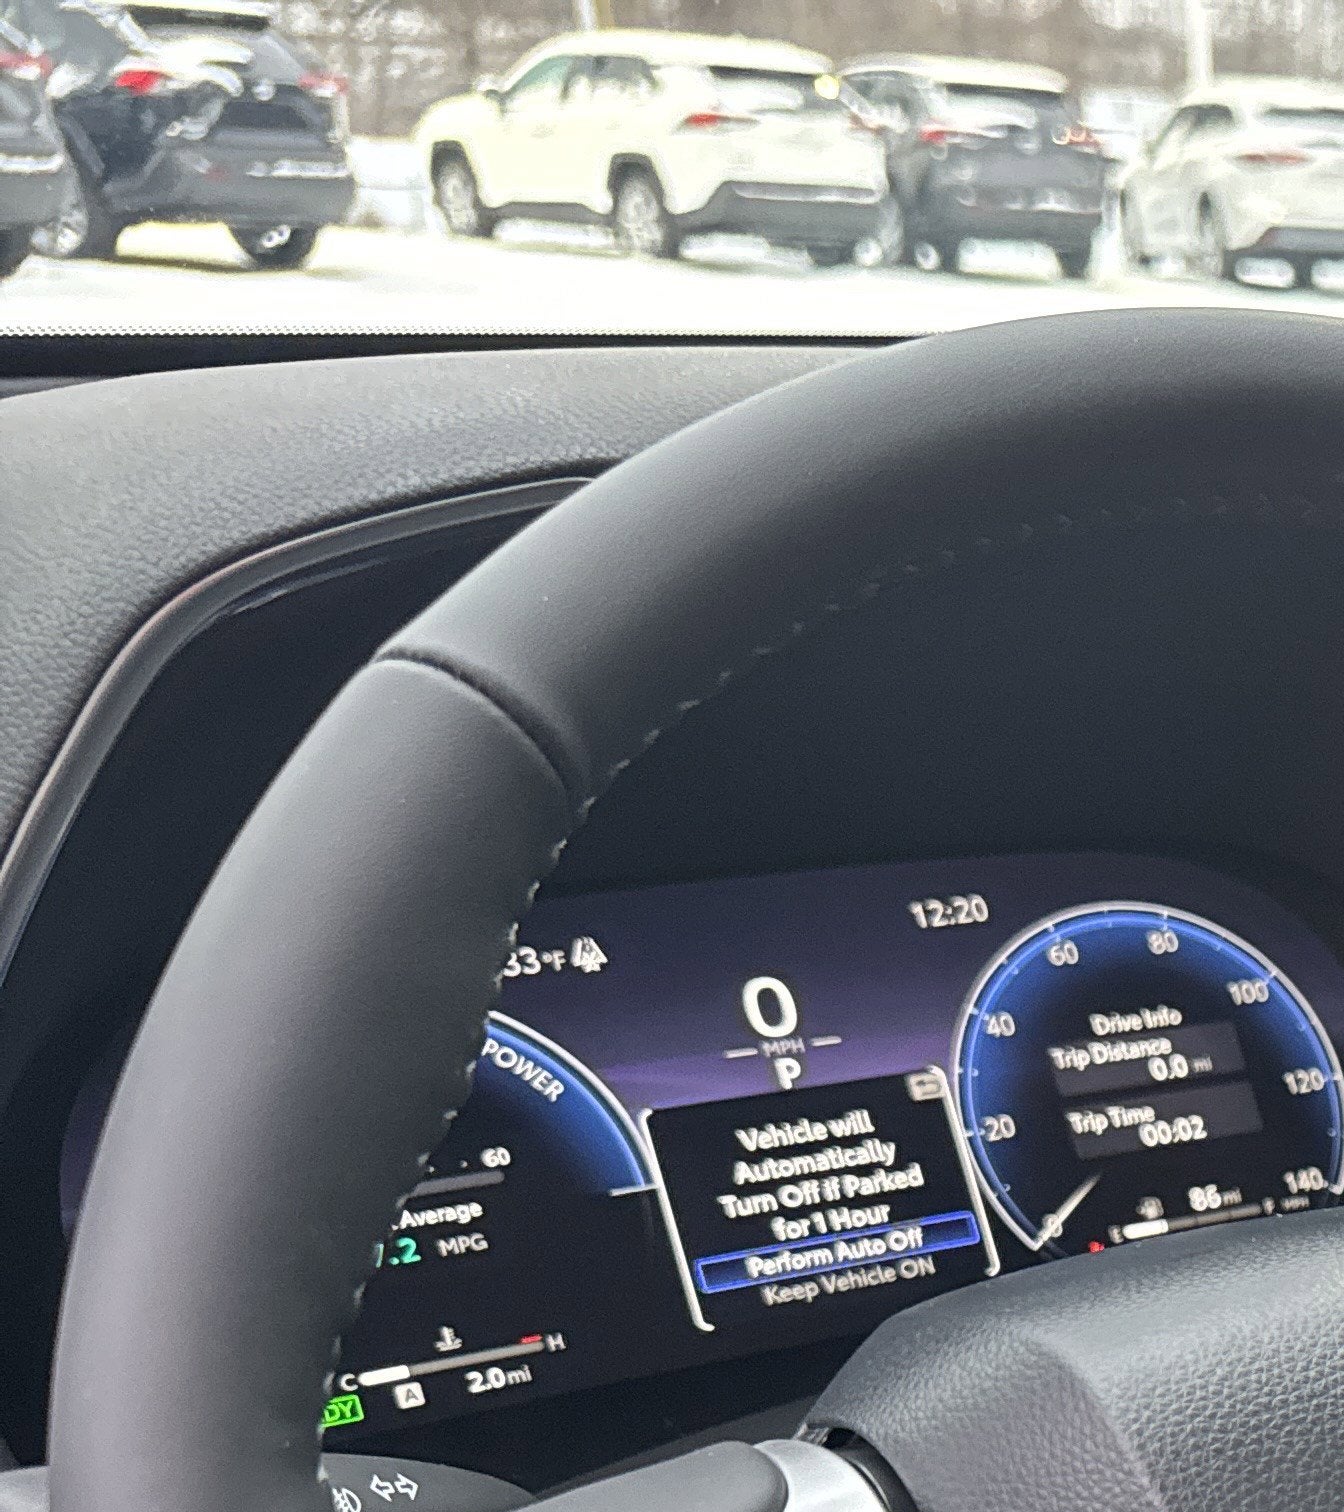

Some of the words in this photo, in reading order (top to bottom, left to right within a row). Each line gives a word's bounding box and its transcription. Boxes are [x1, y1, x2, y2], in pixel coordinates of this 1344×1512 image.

[910, 894, 989, 928] 12:20
[1046, 940, 1080, 966] 60
[1146, 930, 1180, 955] 80
[742, 975, 798, 1038] 0
[1228, 979, 1270, 1005] 100
[984, 1012, 1016, 1038] 40
[1090, 1010, 1138, 1036] Drive
[1139, 1004, 1183, 1031] Info
[481, 1037, 567, 1103] POWER
[1048, 1044, 1091, 1072] Trip
[1091, 1037, 1173, 1065] Distance
[1147, 1056, 1189, 1082] 0.0
[774, 1058, 802, 1090] P
[1283, 1069, 1325, 1096] 120
[734, 1117, 828, 1152] Vehicle
[828, 1108, 875, 1138] will
[984, 1114, 1017, 1142] 20
[1066, 1110, 1109, 1136] Trip
[1105, 1105, 1156, 1129] Time
[1138, 1114, 1208, 1148] 00:02
[480, 1146, 511, 1169] 60
[732, 1137, 896, 1185] Automatically
[716, 1193, 779, 1219] Turn
[777, 1179, 821, 1208] Off
[821, 1177, 841, 1201] if
[839, 1162, 925, 1199] Parked
[399, 1202, 483, 1231] Average
[770, 1215, 811, 1241] for
[811, 1211, 827, 1234] 1
[827, 1204, 891, 1232] Hour
[437, 1232, 489, 1258] MPG
[745, 1246, 834, 1280] Perform
[834, 1237, 886, 1262] Auto
[886, 1225, 923, 1252] Off
[760, 1280, 820, 1307] Keep
[818, 1262, 898, 1294] Vehicle
[899, 1255, 937, 1281] ON
[546, 1332, 566, 1352] H
[340, 1373, 359, 1392] C
